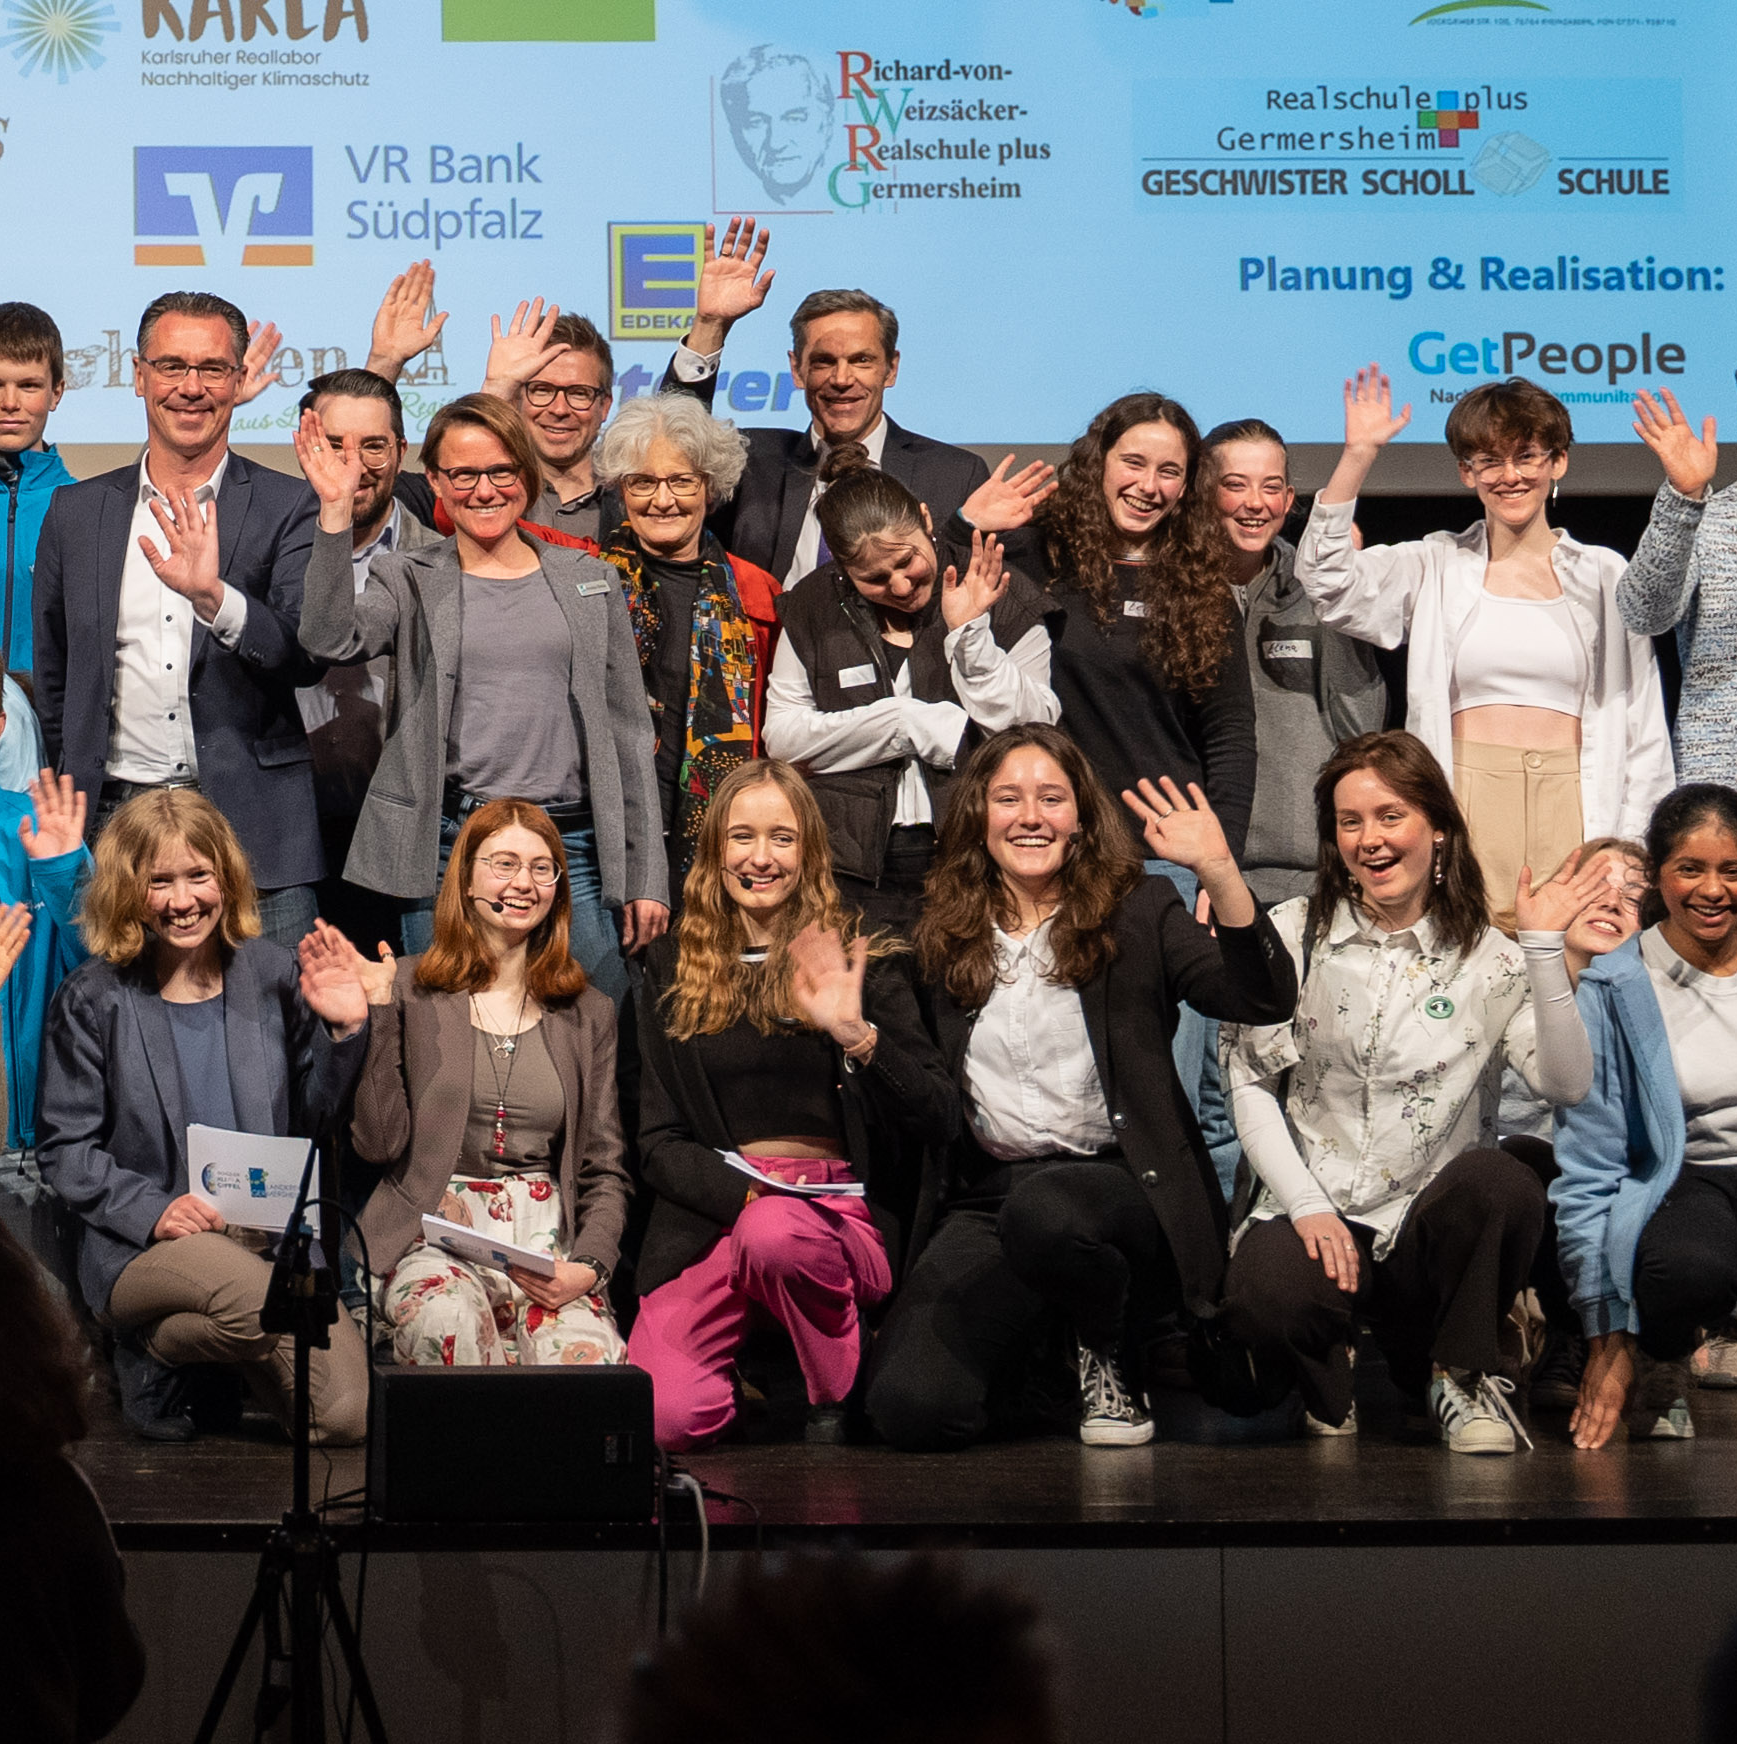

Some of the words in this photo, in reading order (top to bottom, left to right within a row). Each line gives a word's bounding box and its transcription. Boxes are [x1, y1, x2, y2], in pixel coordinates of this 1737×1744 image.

[141, 49, 231, 65] Karlsruher
[236, 49, 323, 65] Reallabor
[835, 50, 1013, 99] Richard-von-
[141, 71, 257, 91] Nachhaltiger
[262, 70, 370, 87] Klimaschutz
[1266, 85, 1432, 111] Realschule
[1463, 85, 1528, 114] plus
[851, 87, 1028, 136] Weizsäcker-
[843, 124, 991, 171] Realschule
[997, 137, 1051, 166] plus
[1217, 127, 1437, 152] Germersheim
[345, 144, 412, 185] VR
[429, 142, 543, 185] Bank
[827, 160, 1022, 209] Germersheim
[1141, 168, 1348, 196] GESCHWISTER
[1362, 168, 1475, 196] SCHOLL
[1557, 168, 1670, 195] SCHULE
[345, 198, 545, 250] Südpfalz
[1239, 255, 1413, 300] Planung
[1427, 256, 1466, 292] &
[1479, 255, 1726, 292] Realisation:
[1408, 330, 1687, 385] GetPeople
